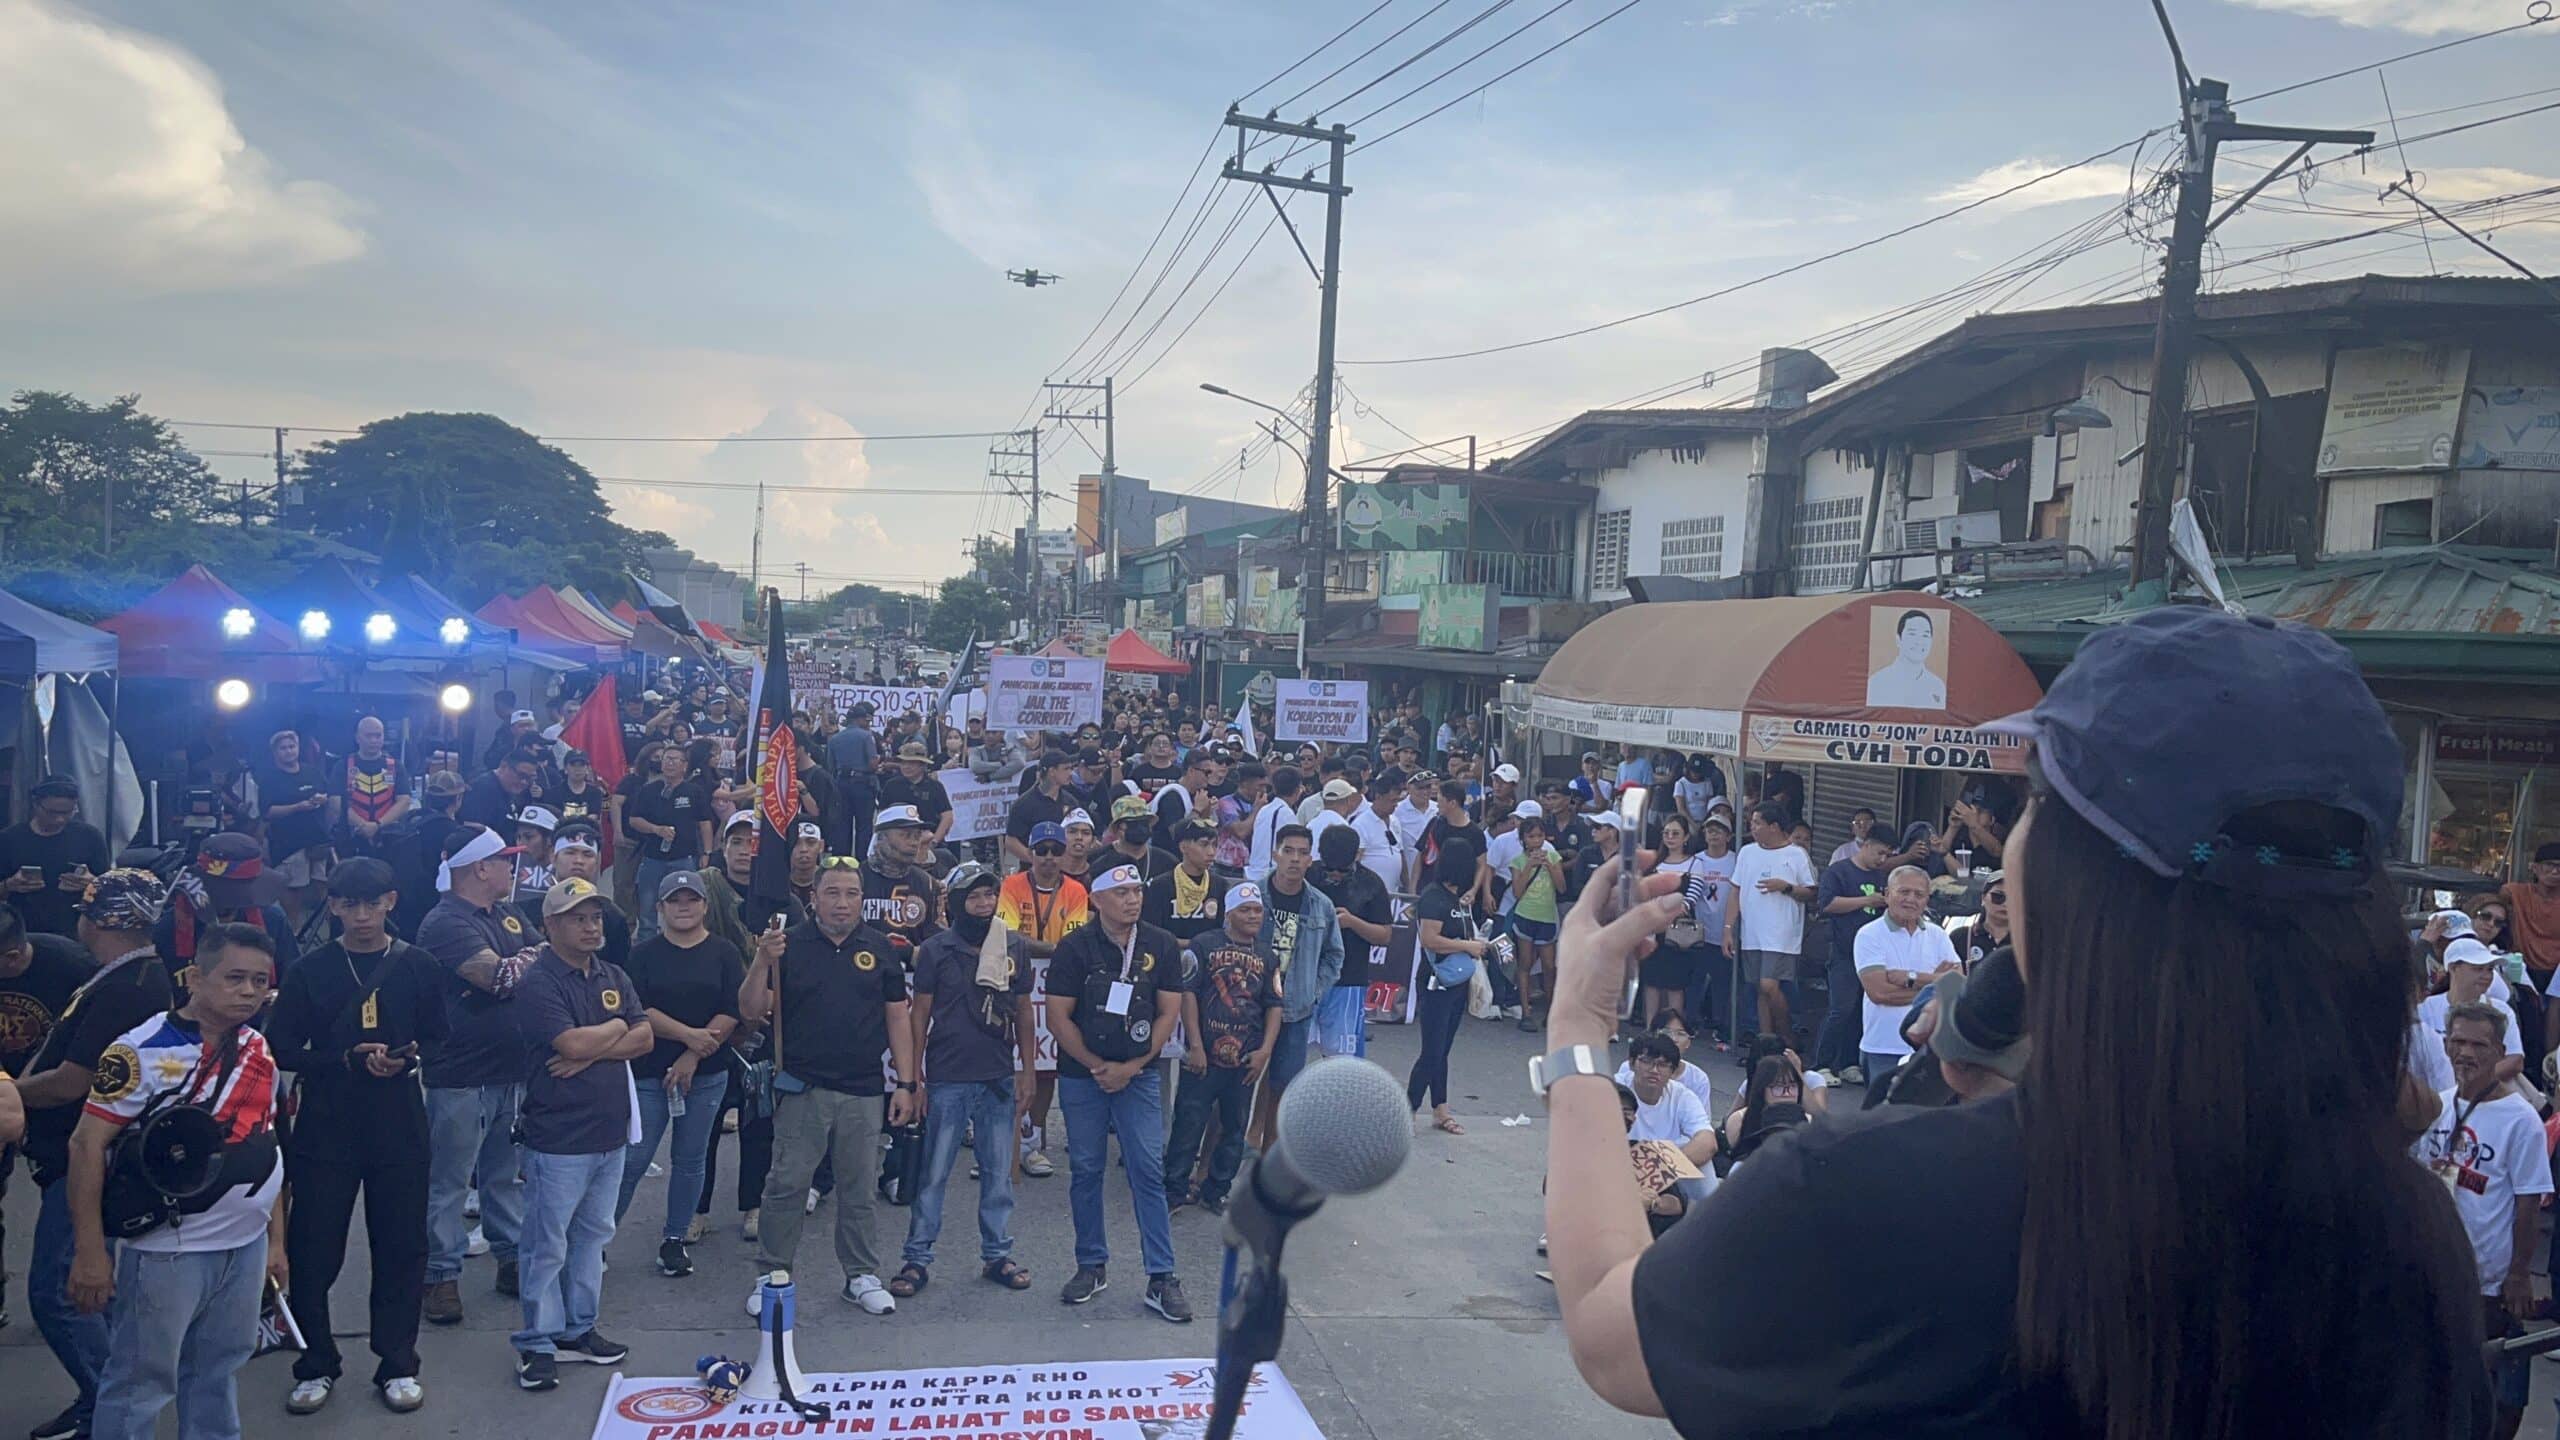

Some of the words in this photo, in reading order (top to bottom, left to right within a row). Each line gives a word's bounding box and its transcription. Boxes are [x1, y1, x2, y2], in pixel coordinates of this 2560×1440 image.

[1024, 695, 1047, 710] JAIL
[1050, 696, 1071, 710] THE
[1017, 711, 1075, 726] CORRUPT!
[1287, 710, 1342, 724] KORAPSYON
[1344, 712, 1357, 724] AY
[1640, 709, 1665, 725] LAZATIN
[1793, 720, 1870, 739] CARMELO
[1934, 728, 1999, 746] LAZATIN
[2440, 736, 2493, 750] Fresh
[1826, 741, 1891, 763] CVH
[1905, 745, 1992, 769] TODA
[811, 1379, 907, 1393] ALPHA
[923, 1374, 1017, 1389] KAPPA
[1032, 1370, 1088, 1383] RHO
[739, 1400, 873, 1415] KILAN
[890, 1394, 1010, 1409] KONTRA
[1026, 1387, 1163, 1402] KURAKOT
[647, 1418, 874, 1440] PANAGUTIN
[889, 1411, 1010, 1432] LAHAT
[1023, 1407, 1071, 1425] NG
